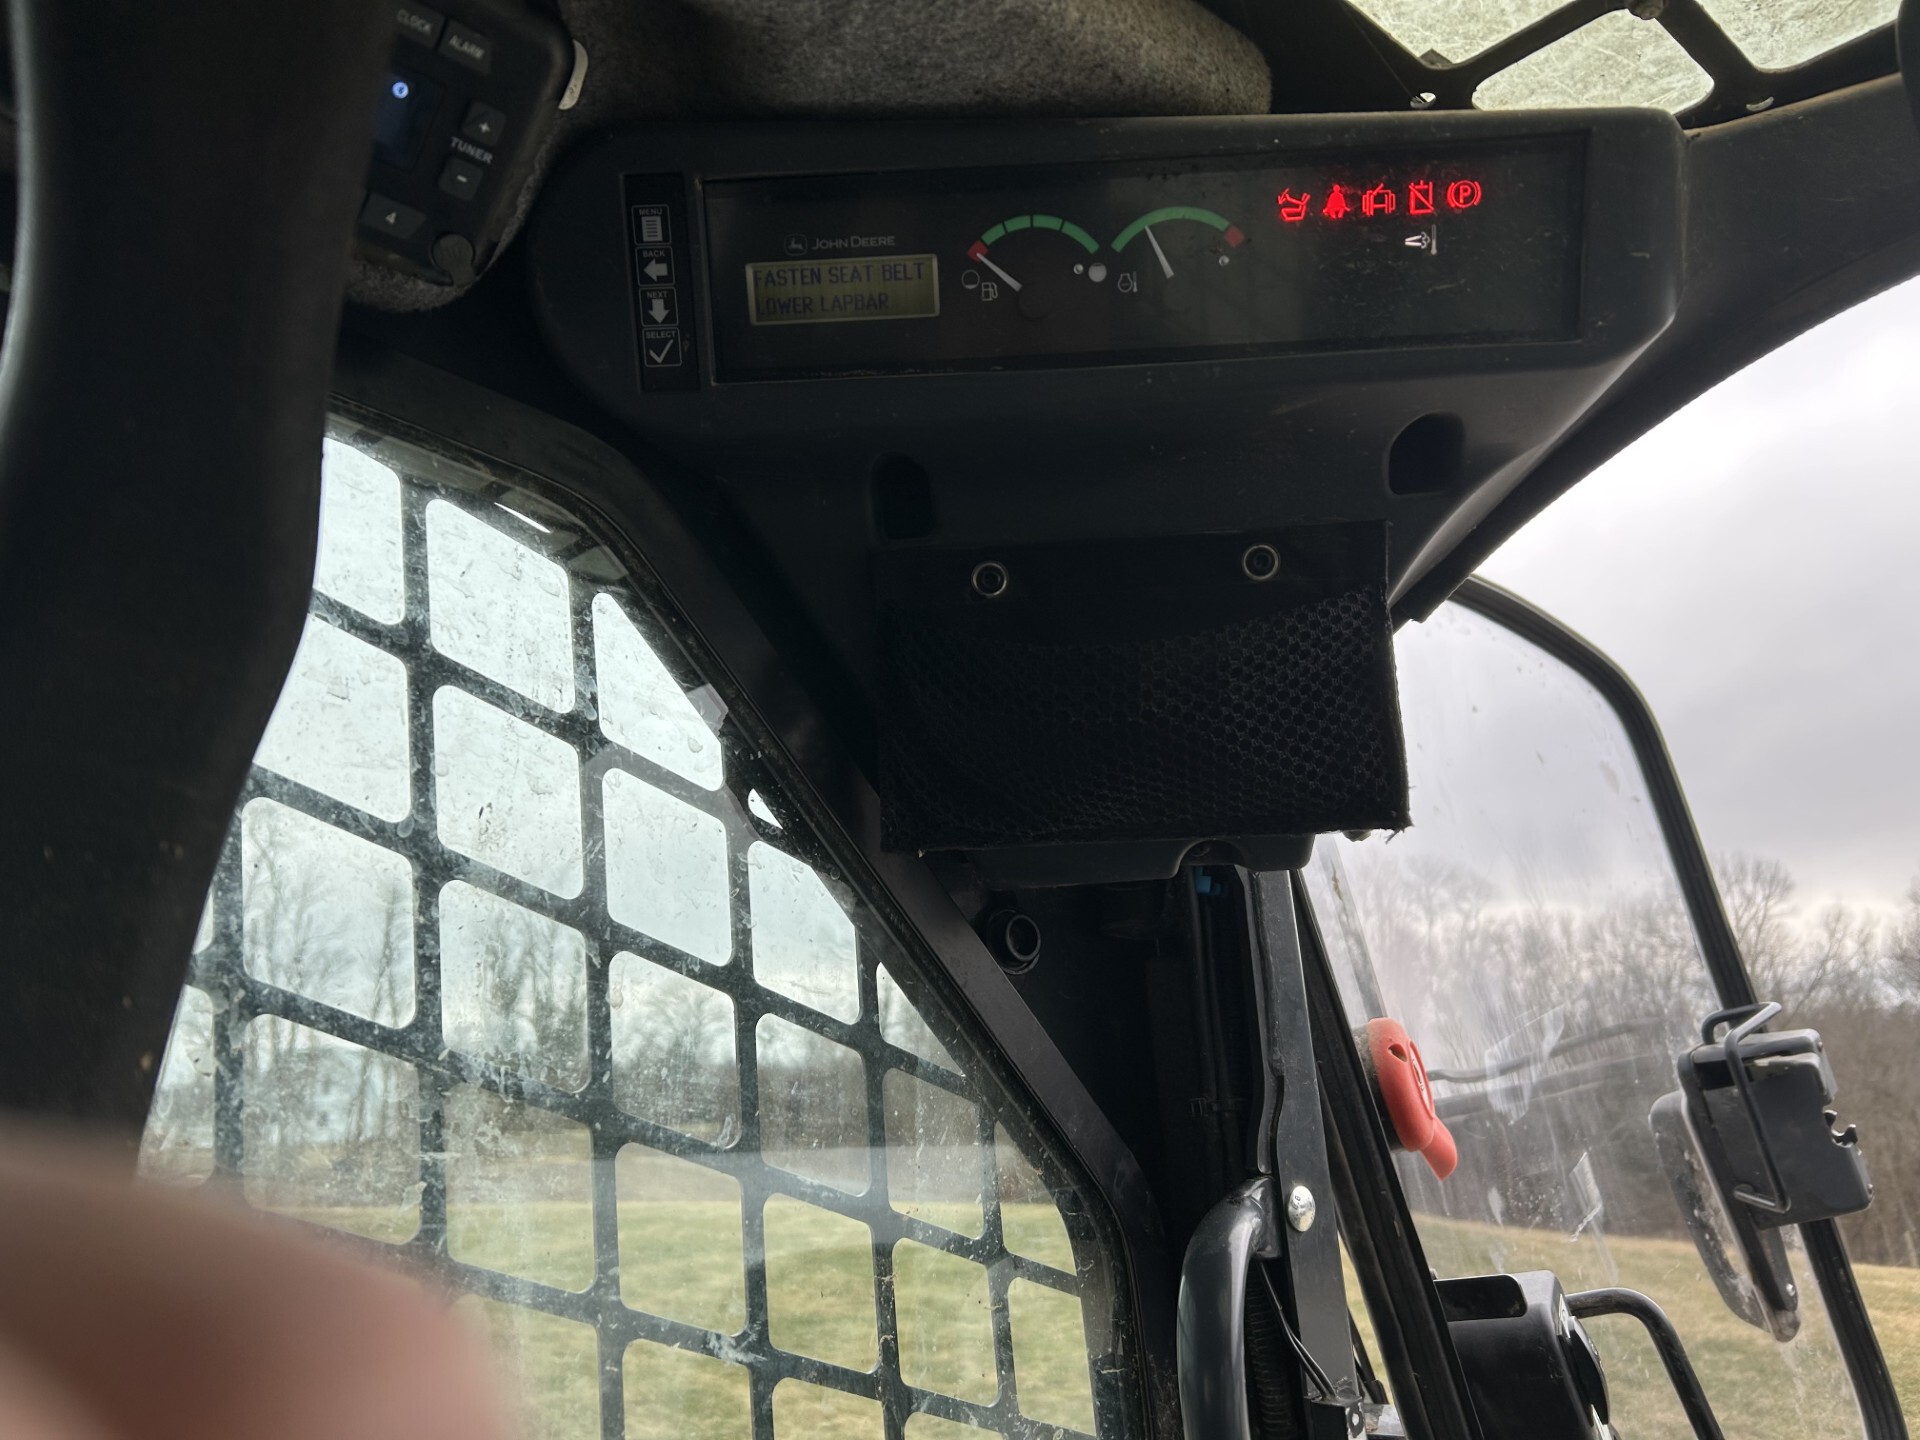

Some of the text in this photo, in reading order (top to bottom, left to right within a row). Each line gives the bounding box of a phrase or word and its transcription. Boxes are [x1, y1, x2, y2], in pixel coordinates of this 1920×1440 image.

[448, 34, 486, 60] ALARM
[449, 136, 494, 164] TUNER
[639, 208, 663, 216] MENU
[811, 235, 896, 250] JOHN DEERE
[642, 250, 666, 258] BACK
[754, 262, 925, 288] FASTEN SEAT BELT
[646, 290, 668, 299] NEXT
[820, 293, 890, 313] LAPBAR
[645, 330, 677, 340] SELECT
